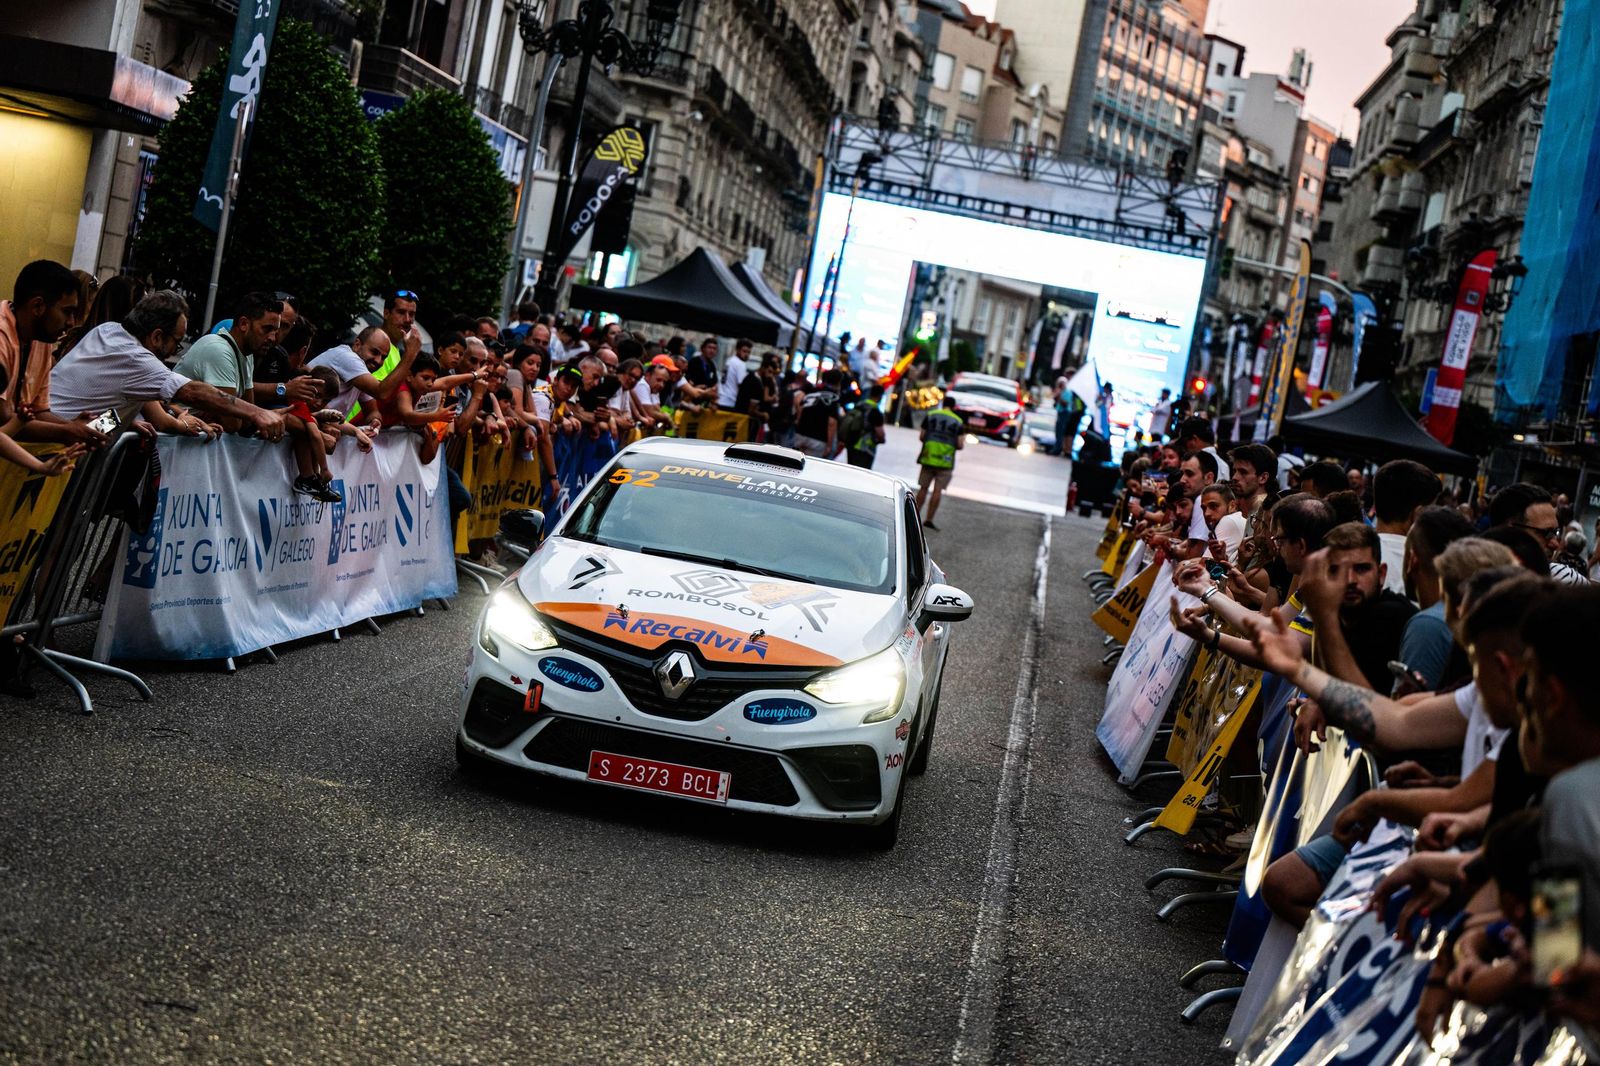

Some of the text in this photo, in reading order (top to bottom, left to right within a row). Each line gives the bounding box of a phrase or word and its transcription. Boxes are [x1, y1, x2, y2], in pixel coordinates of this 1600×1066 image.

[608, 468, 661, 488] 52
[660, 464, 819, 498] DRIVELAND
[736, 483, 817, 504] MOTORSPORT
[279, 537, 315, 565] GALEGO
[341, 523, 358, 554] DE
[161, 540, 185, 577] DE
[627, 588, 770, 621] ROMBOSOL
[932, 595, 963, 608] ARC
[629, 618, 742, 652] Recalvi
[542, 659, 599, 690] Fuengirola
[748, 704, 811, 720] Fuengirola
[599, 758, 716, 796] S 2373 BCL
